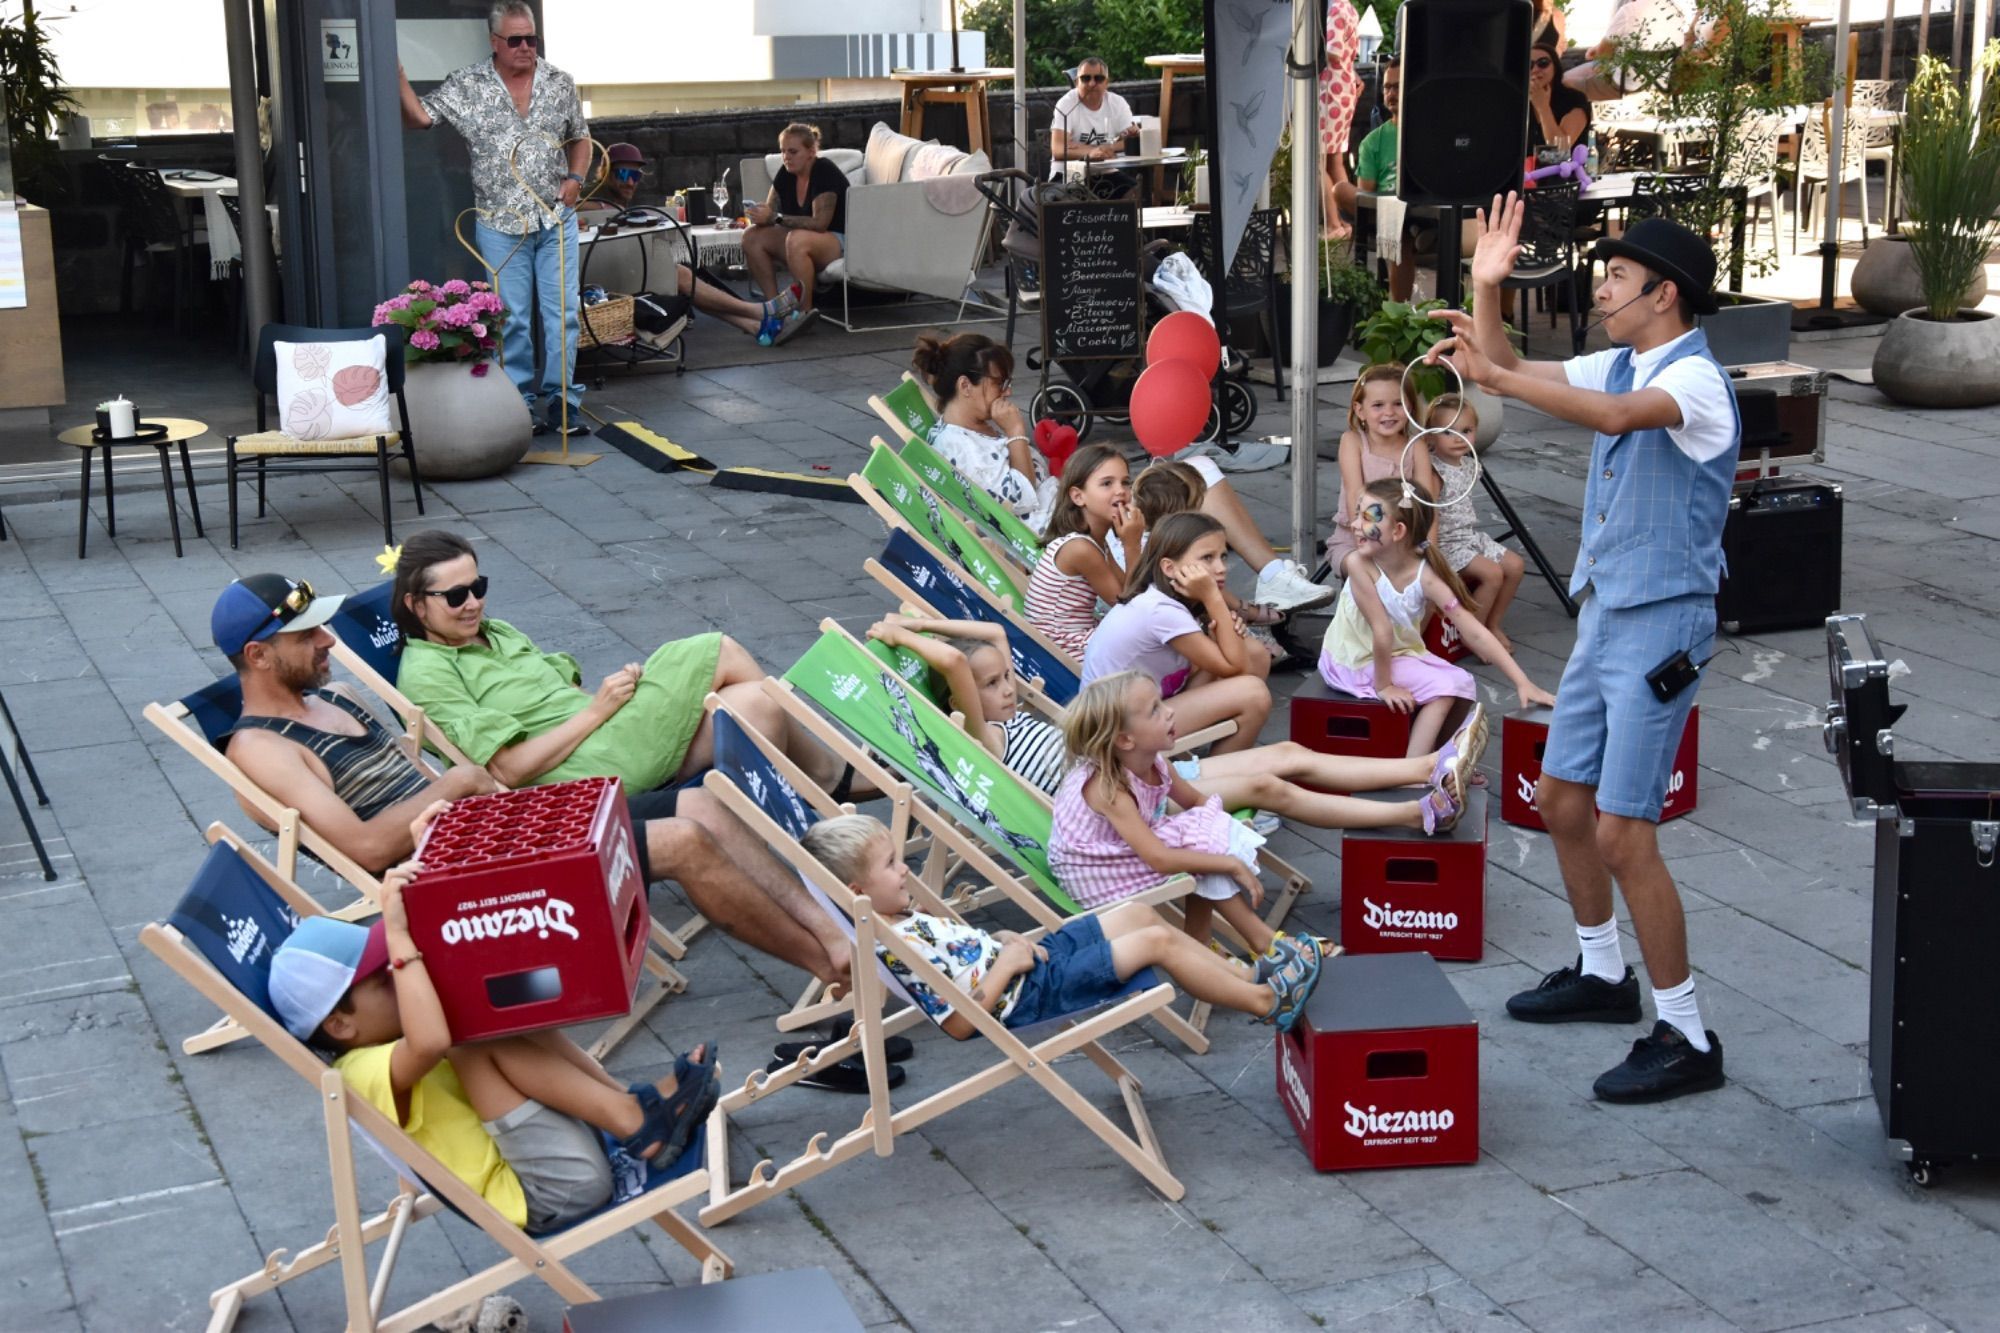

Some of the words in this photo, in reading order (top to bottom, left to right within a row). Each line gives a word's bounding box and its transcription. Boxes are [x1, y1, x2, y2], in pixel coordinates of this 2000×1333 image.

[1062, 208, 1129, 225] Eissorten
[1071, 230, 1114, 243] Schoko
[1071, 244, 1114, 257] Vanille
[369, 627, 400, 649] blude
[480, 897, 498, 907] SEIT
[500, 888, 547, 904] ERFRISCHT
[457, 901, 478, 912] 1927
[1363, 897, 1458, 930] Diezano
[441, 898, 579, 945] Diezano
[1344, 1101, 1454, 1138] Diezano
[1363, 1137, 1402, 1146] ERFRISCHT
